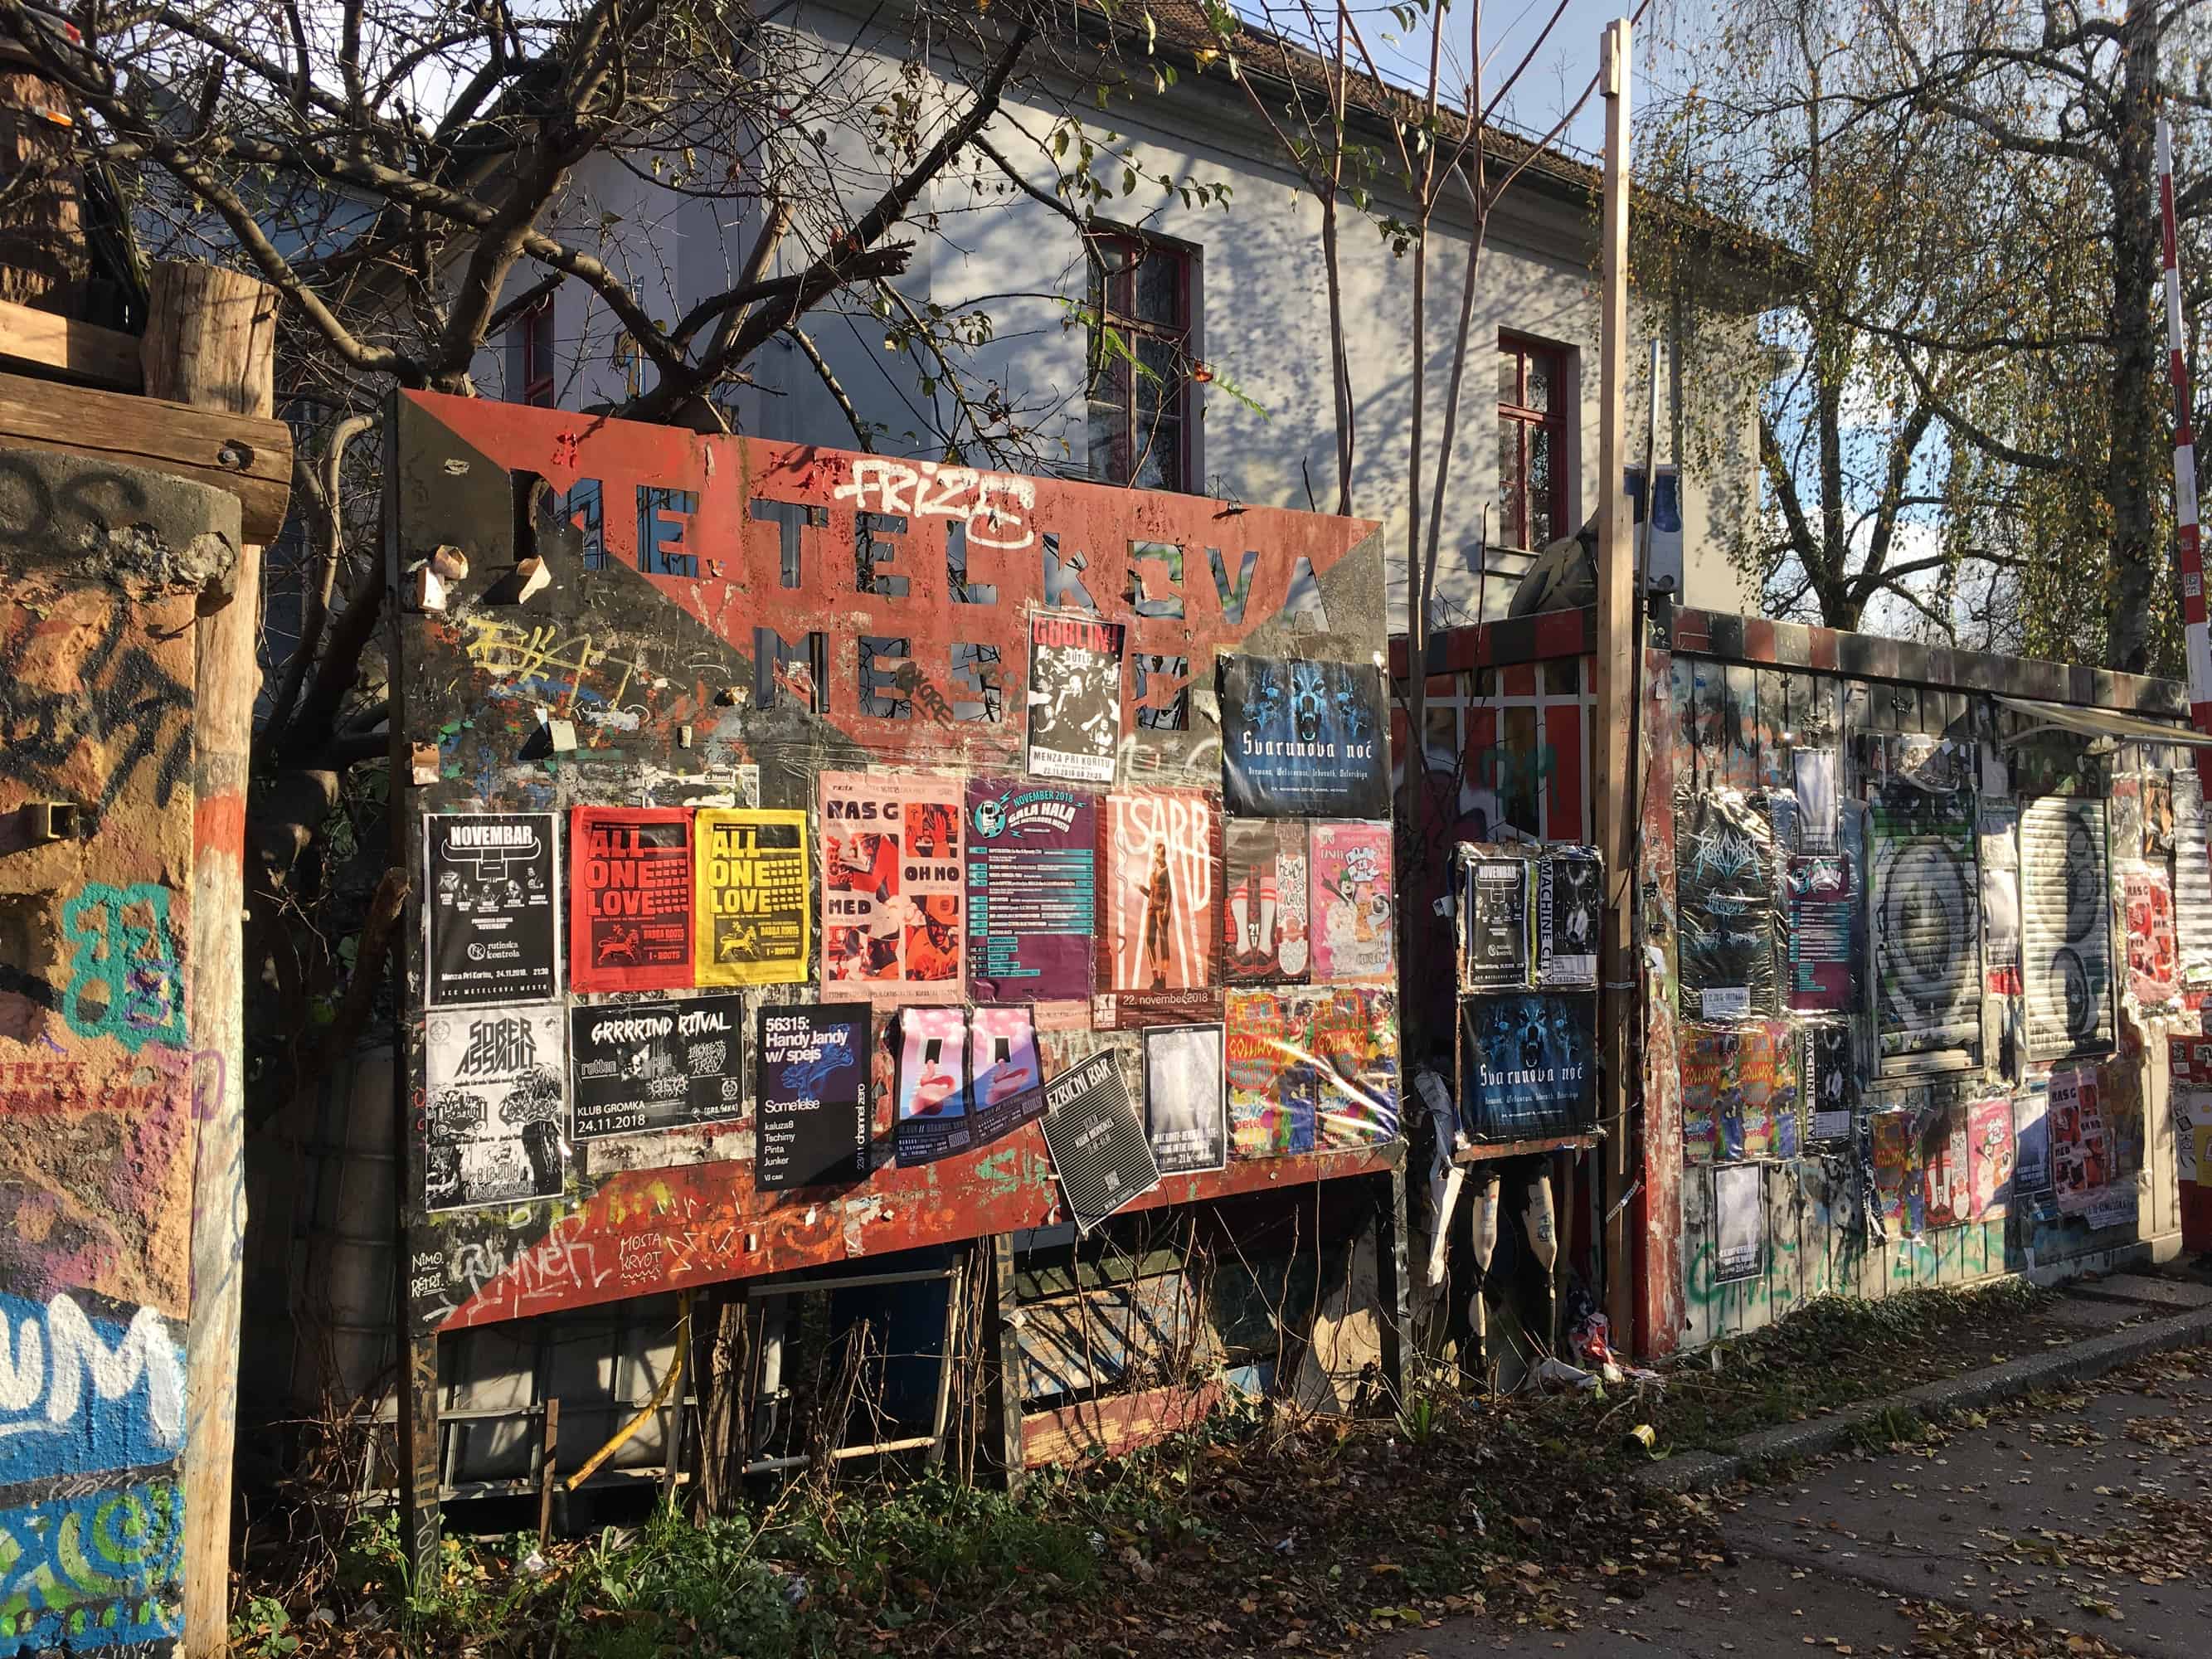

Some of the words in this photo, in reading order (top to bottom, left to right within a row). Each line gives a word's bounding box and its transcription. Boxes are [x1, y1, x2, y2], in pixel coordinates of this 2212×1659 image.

[753, 626, 1189, 732] MESO
[1242, 730, 1334, 757] Svarunova
[1033, 752, 1062, 764] MENZA
[1064, 754, 1079, 765] PRI
[1081, 756, 1111, 769] KORITU
[827, 800, 878, 820] RAS
[882, 802, 899, 820] G
[1013, 790, 1054, 808] NOVEMBER
[1055, 790, 1074, 803] 2018
[1008, 803, 1039, 824] GALA
[1040, 802, 1077, 824] HALA
[450, 825, 533, 846] NOVEMBAR
[588, 830, 644, 858] ALL
[711, 830, 761, 858] ALL
[584, 859, 657, 888] ONE
[707, 859, 772, 887] ONE
[904, 866, 931, 882] OH
[934, 866, 960, 881] NO
[587, 889, 657, 917] LOVE
[710, 888, 772, 913] LOVE
[829, 899, 871, 914] MED
[1540, 860, 1553, 941] MACHINE
[1248, 922, 1260, 936] 21
[486, 949, 521, 960] kontrola
[1541, 946, 1553, 985] CITY
[1122, 995, 1137, 1005] 22.
[1186, 992, 1208, 1003] 2018
[469, 1017, 537, 1048] SOBER
[766, 1016, 810, 1033] 56315:
[766, 1032, 810, 1048] Handy
[810, 1030, 848, 1047] Jandy
[454, 1041, 537, 1078] ASSAULT
[765, 1048, 785, 1063] w/
[786, 1046, 822, 1063] spejs
[1805, 1029, 1816, 1101] MACHINE
[1087, 1058, 1112, 1090] BAR
[1479, 1063, 1554, 1087] Svarunova
[857, 1082, 866, 1105] zero
[2051, 1088, 2070, 1103] RAS
[576, 1104, 602, 1117] KLUB
[603, 1100, 646, 1114] GROMKA
[764, 1099, 821, 1114] Some1else
[577, 1114, 646, 1133] 24.11.2018
[854, 1105, 867, 1145] channel
[1806, 1105, 1816, 1138] CITY
[764, 1144, 785, 1155] Pinta
[619, 1233, 663, 1259] MOSTA
[620, 1251, 663, 1272] KRYOT
